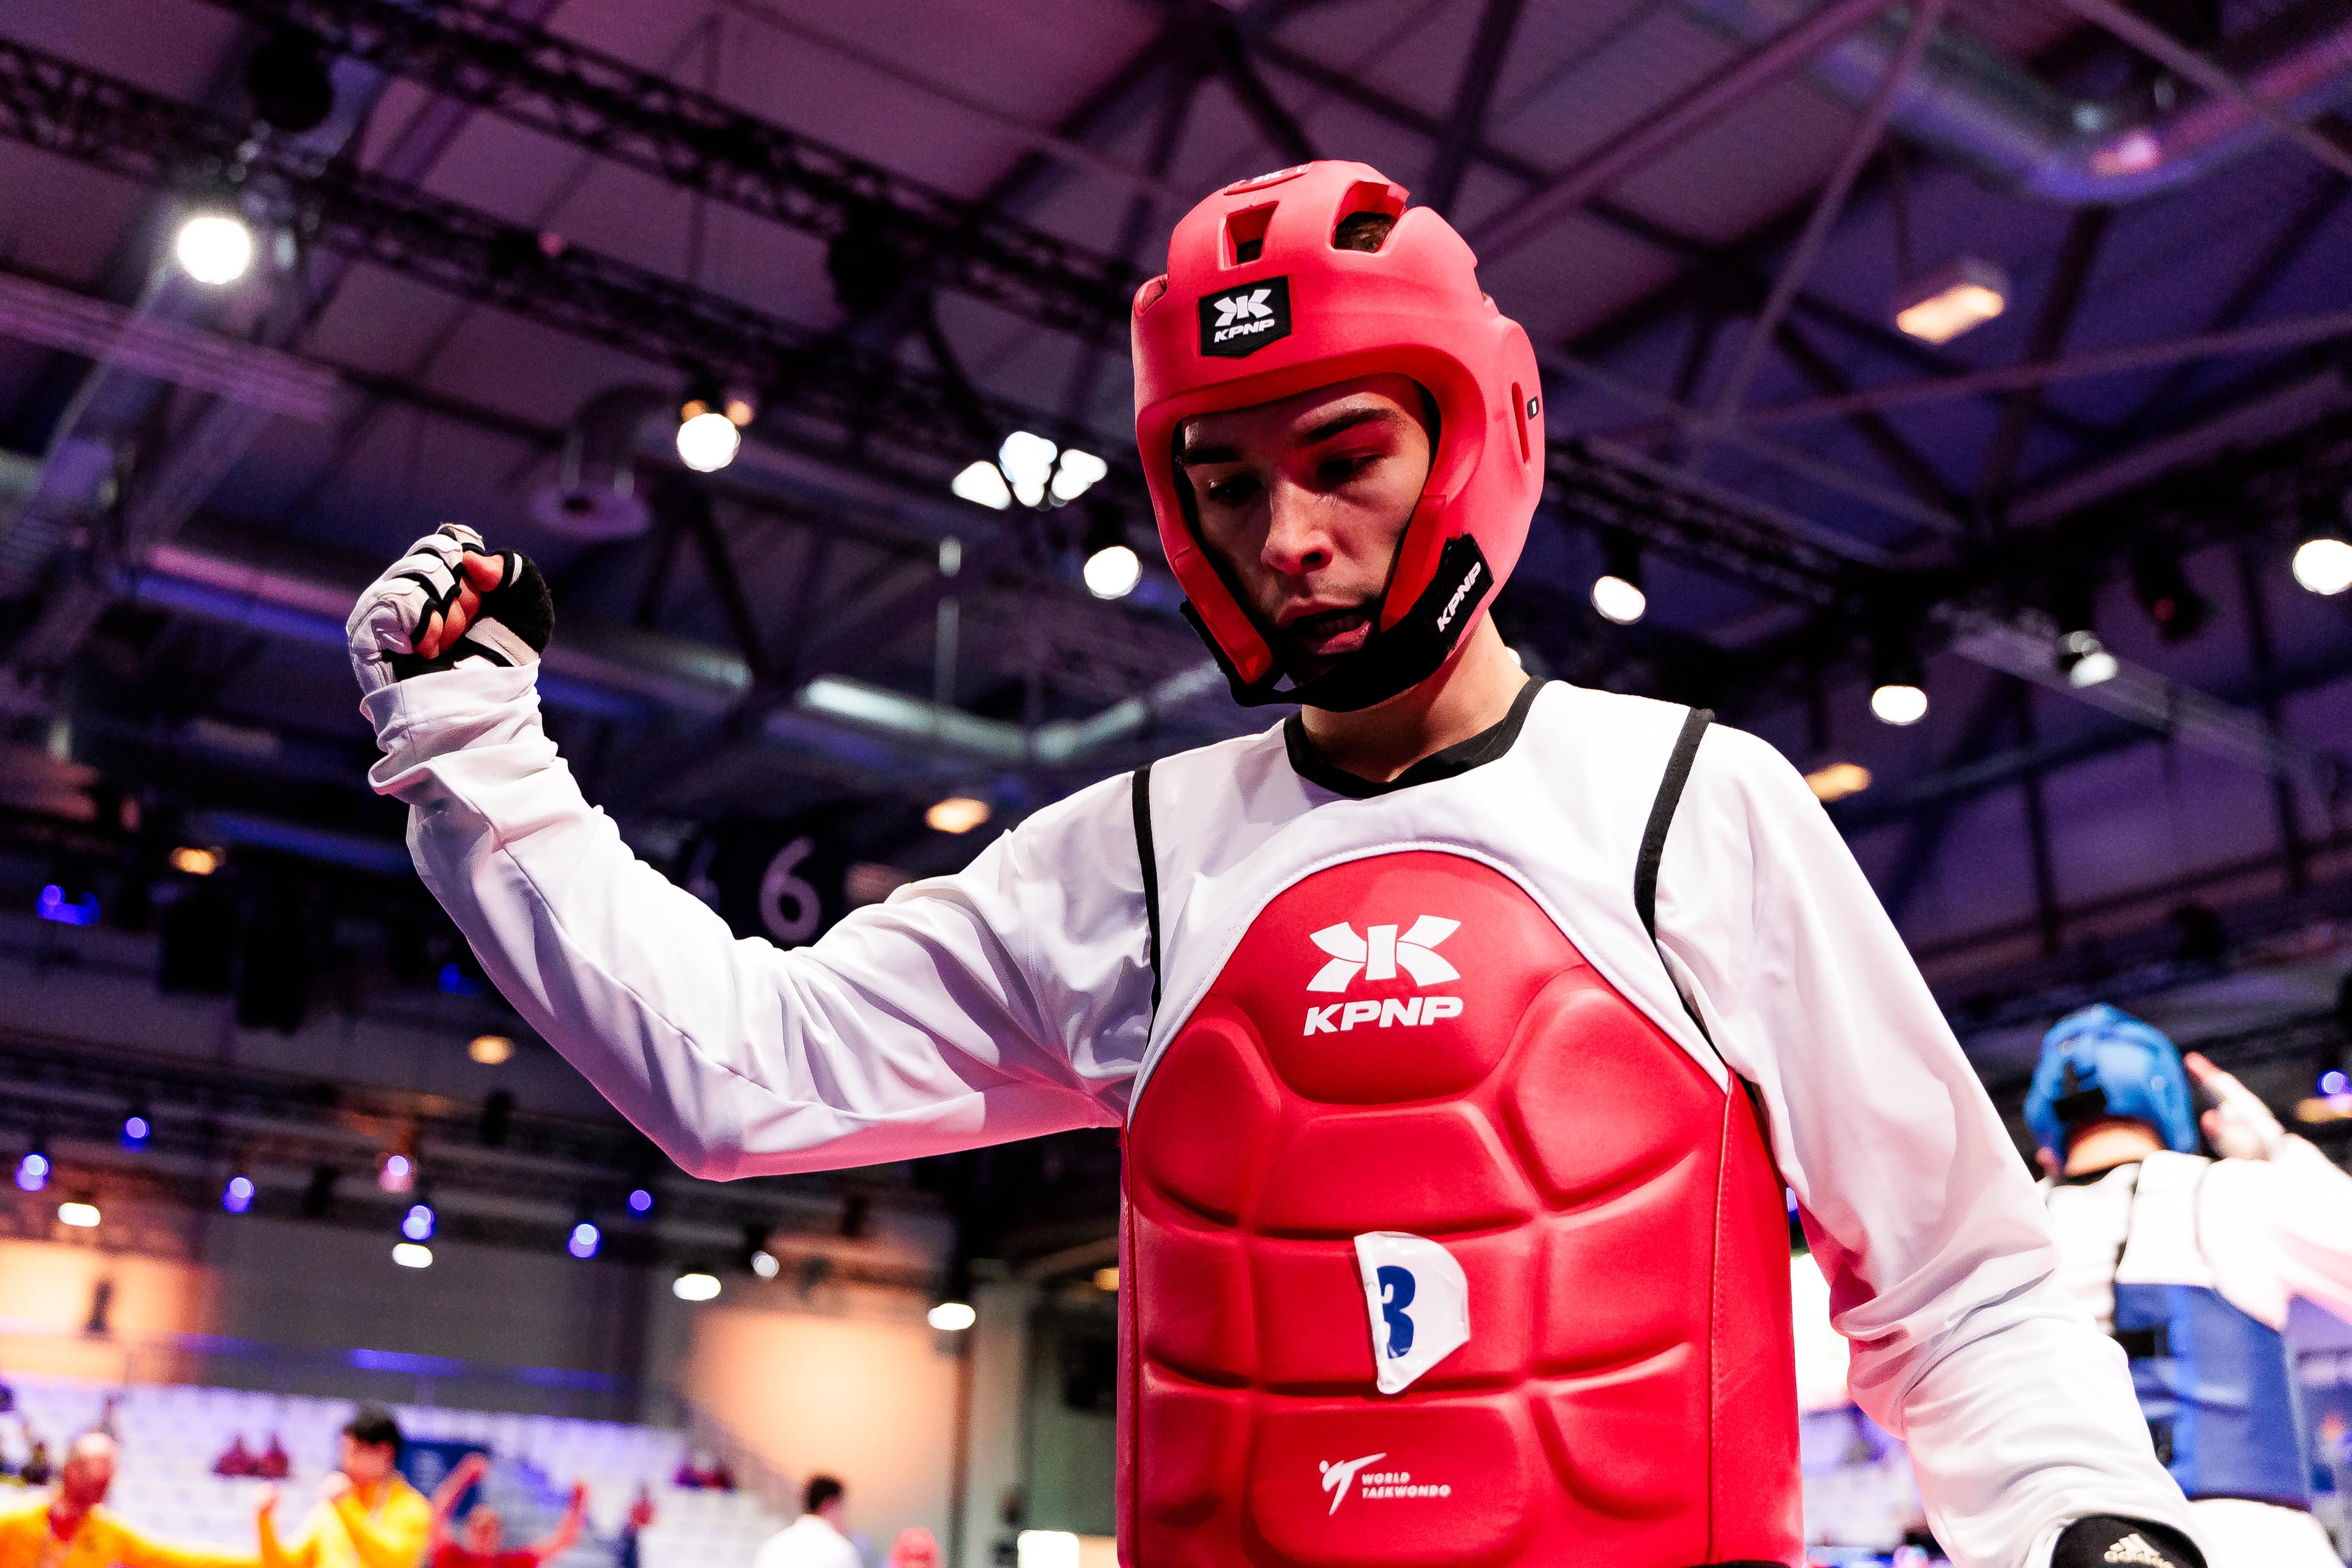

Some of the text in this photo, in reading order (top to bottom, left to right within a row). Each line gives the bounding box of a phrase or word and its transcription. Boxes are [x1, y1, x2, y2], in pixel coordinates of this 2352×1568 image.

[1214, 318, 1275, 343] KPNP
[1437, 562, 1481, 632] KPNP
[758, 834, 822, 943] 6
[1303, 996, 1463, 1036] KPNP
[1376, 1266, 1416, 1359] 3
[1362, 1472, 1410, 1485] WORLD
[1362, 1484, 1452, 1499] TAEKWONDO
